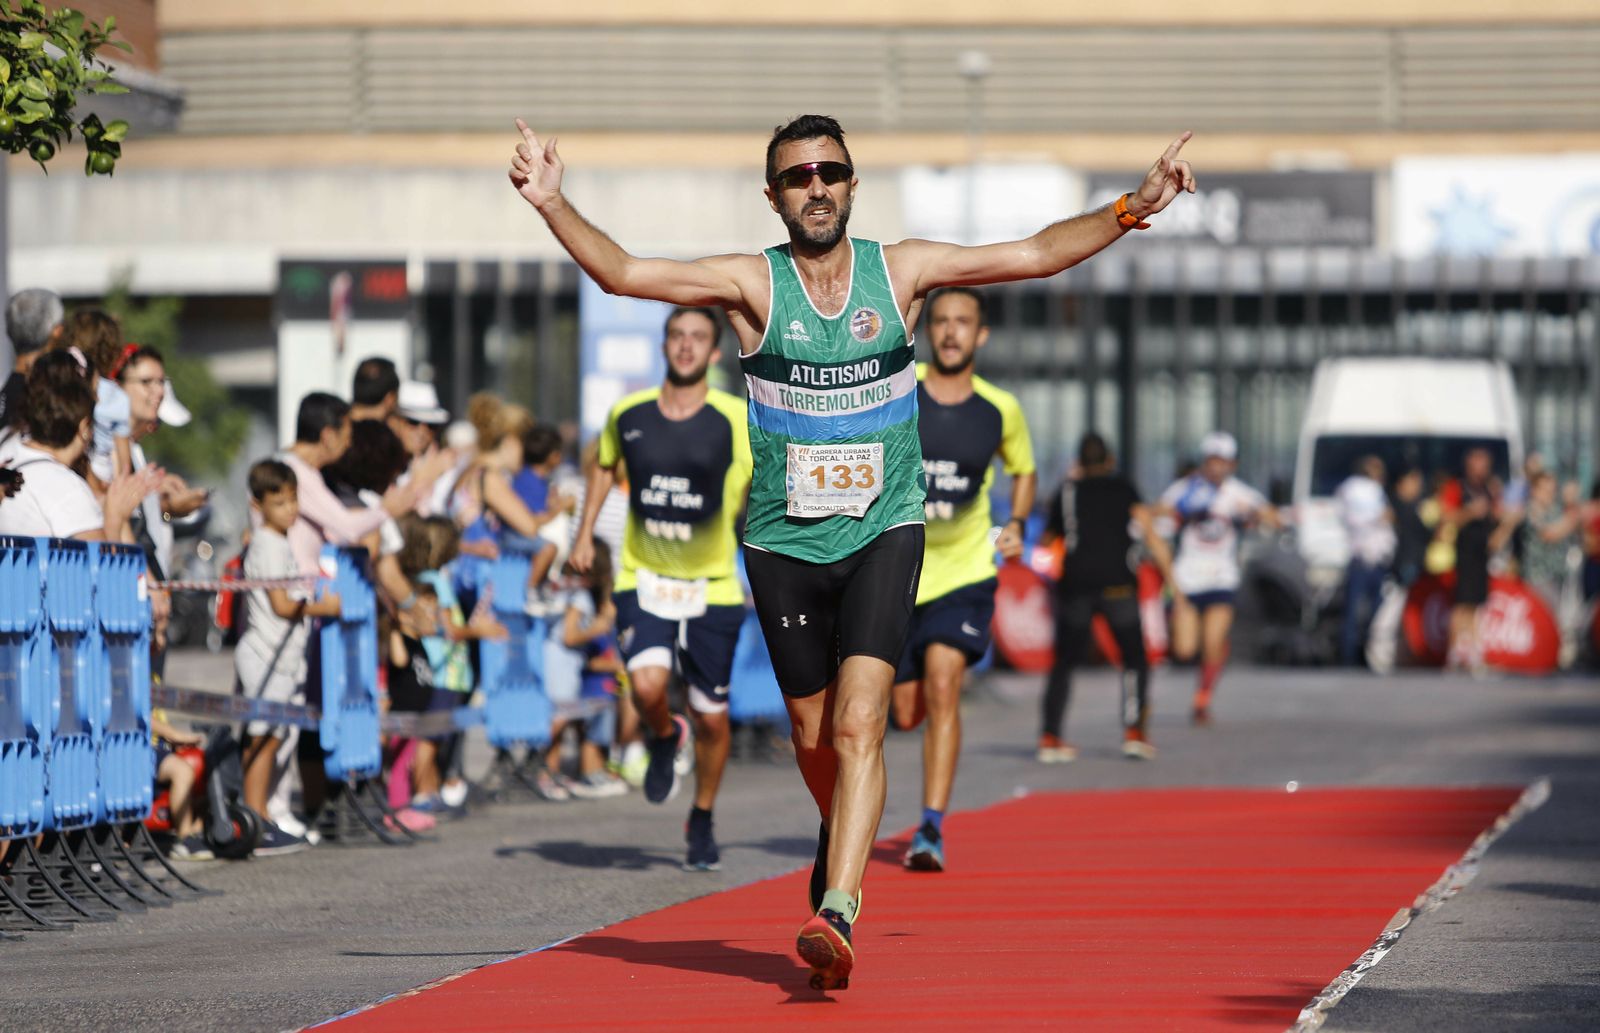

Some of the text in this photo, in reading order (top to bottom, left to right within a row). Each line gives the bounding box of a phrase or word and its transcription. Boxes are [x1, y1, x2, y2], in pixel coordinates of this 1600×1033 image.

[790, 359, 880, 386] ATLETISMO
[778, 383, 892, 412] TORREMOLINOS
[809, 464, 875, 490] 133
[803, 504, 846, 512] DISMOAUTO
